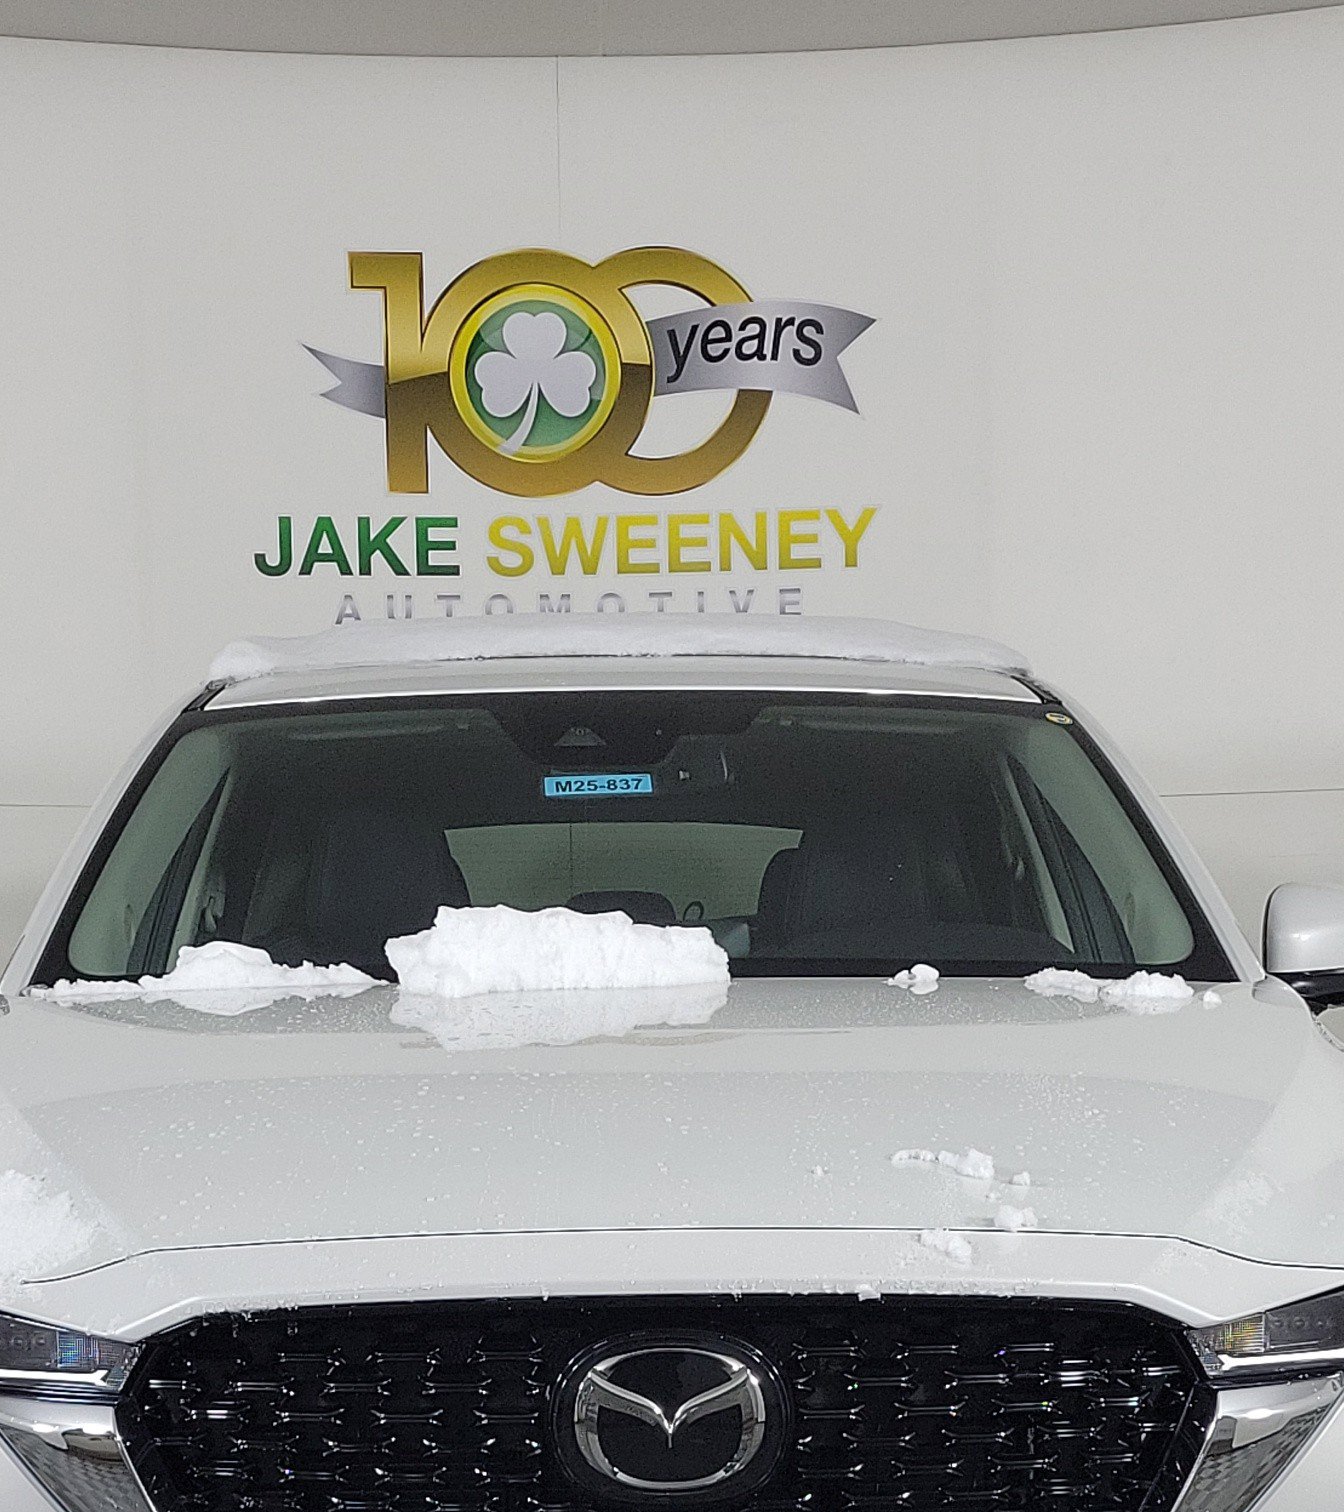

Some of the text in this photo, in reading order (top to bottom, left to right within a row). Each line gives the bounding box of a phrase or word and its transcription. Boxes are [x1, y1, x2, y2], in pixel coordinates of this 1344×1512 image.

[347, 246, 824, 498] 100 years
[254, 507, 877, 577] JAKE SWEENEY
[554, 778, 643, 793] M25-837
